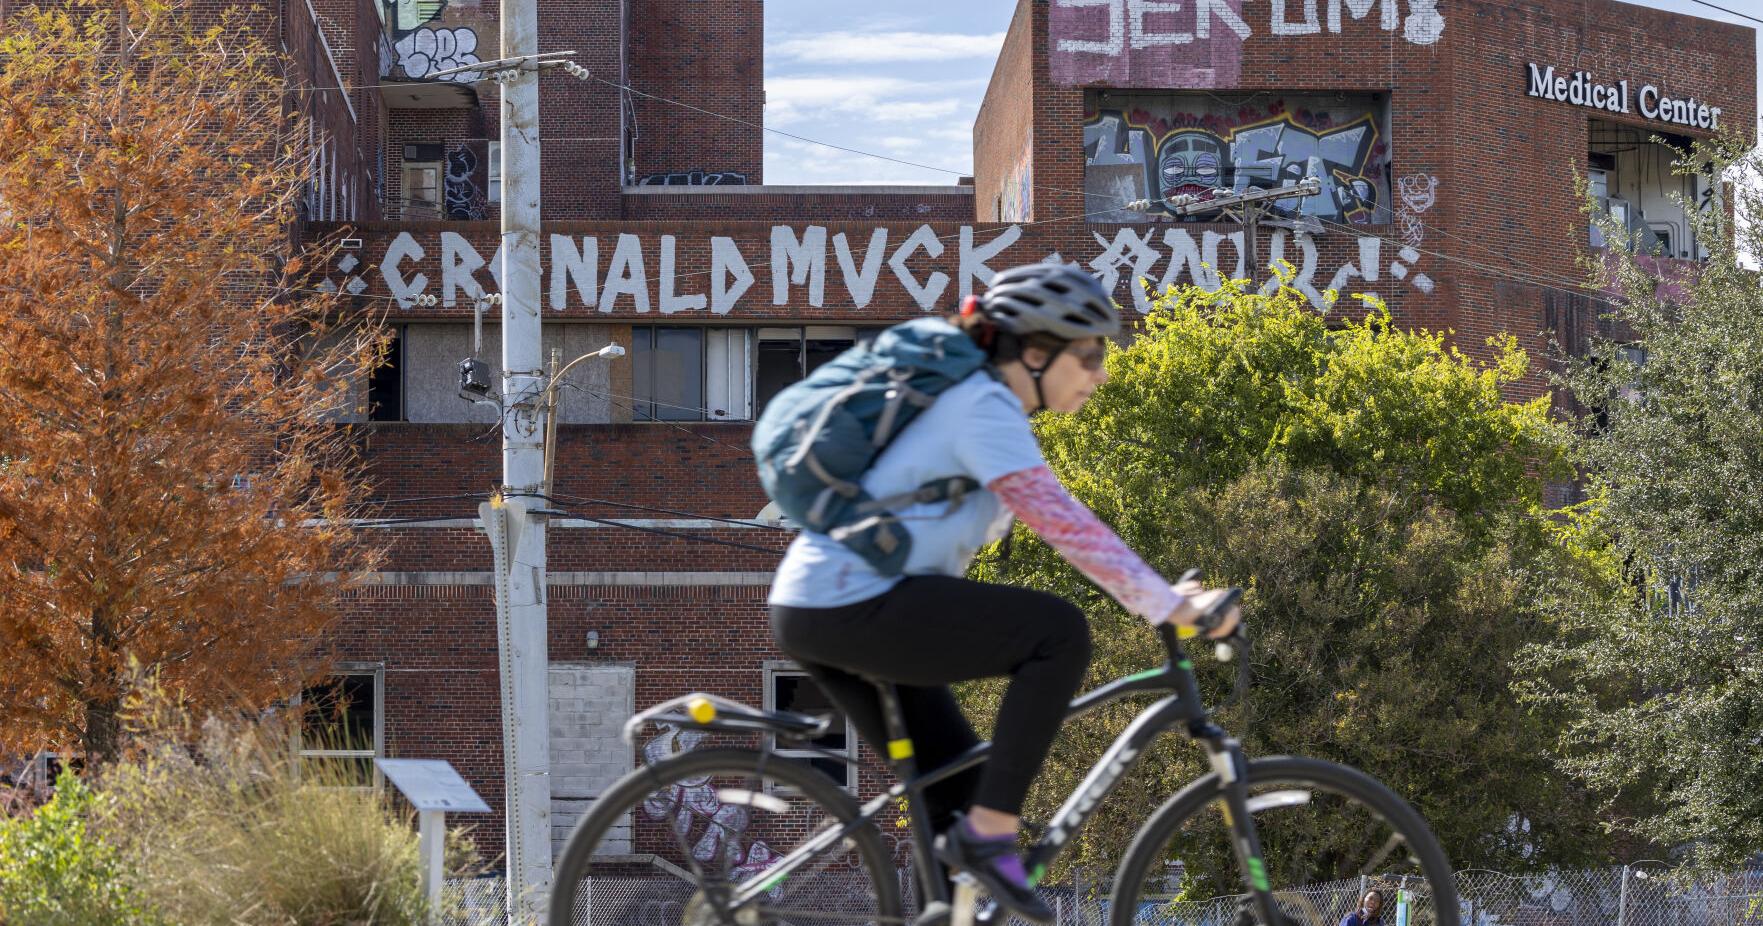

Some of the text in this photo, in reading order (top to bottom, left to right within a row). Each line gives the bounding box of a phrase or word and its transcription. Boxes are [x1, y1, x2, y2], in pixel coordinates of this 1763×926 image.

[1526, 62, 1723, 130] Medical Center
[379, 231, 756, 315] CRNALD
